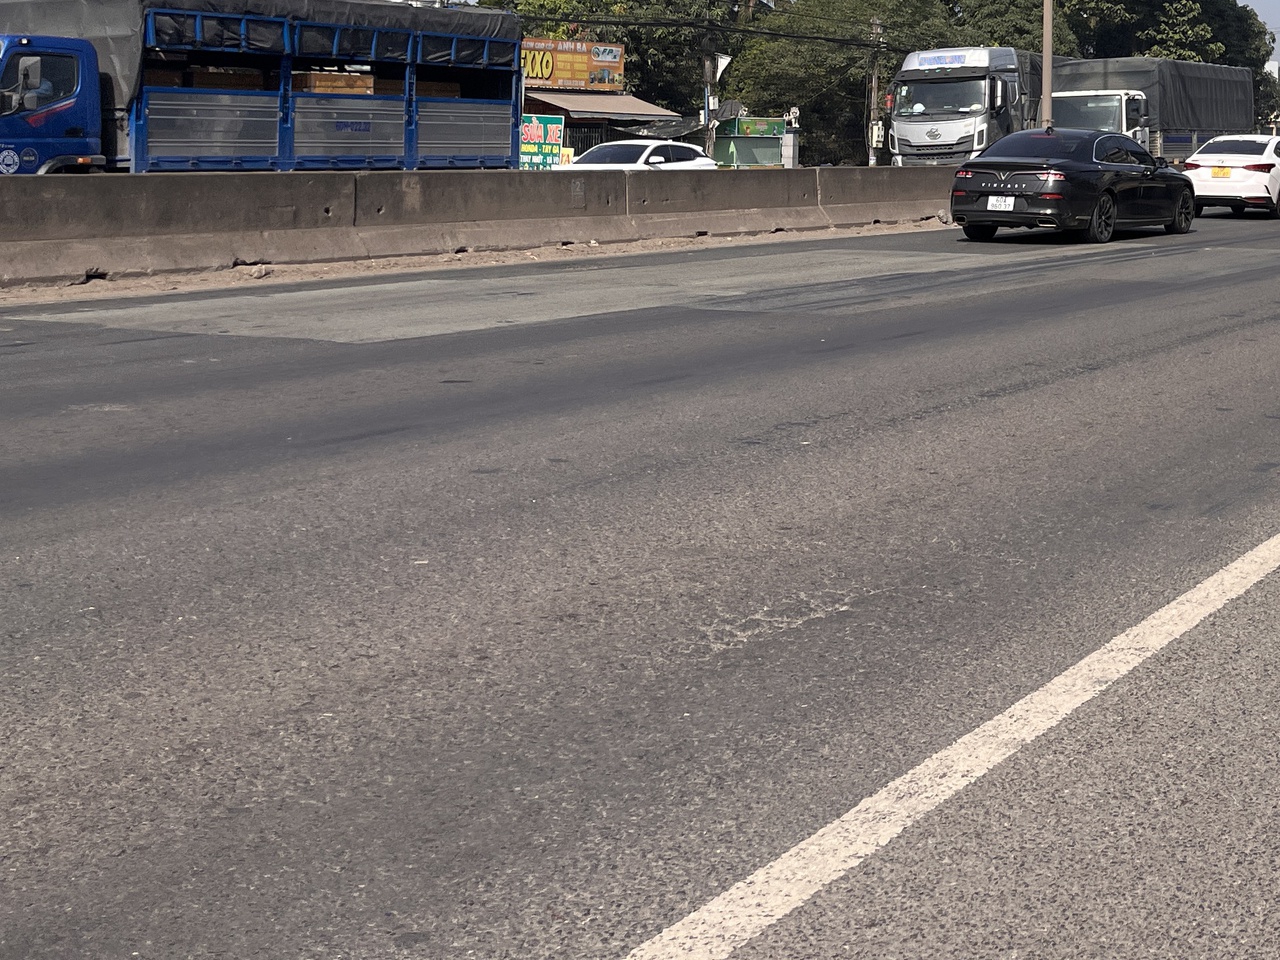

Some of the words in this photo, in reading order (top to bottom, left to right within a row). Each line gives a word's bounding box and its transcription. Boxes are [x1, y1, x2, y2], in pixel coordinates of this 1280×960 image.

[557, 41, 575, 52] ANH
[522, 116, 544, 143] SỬA
[546, 124, 562, 143] XE
